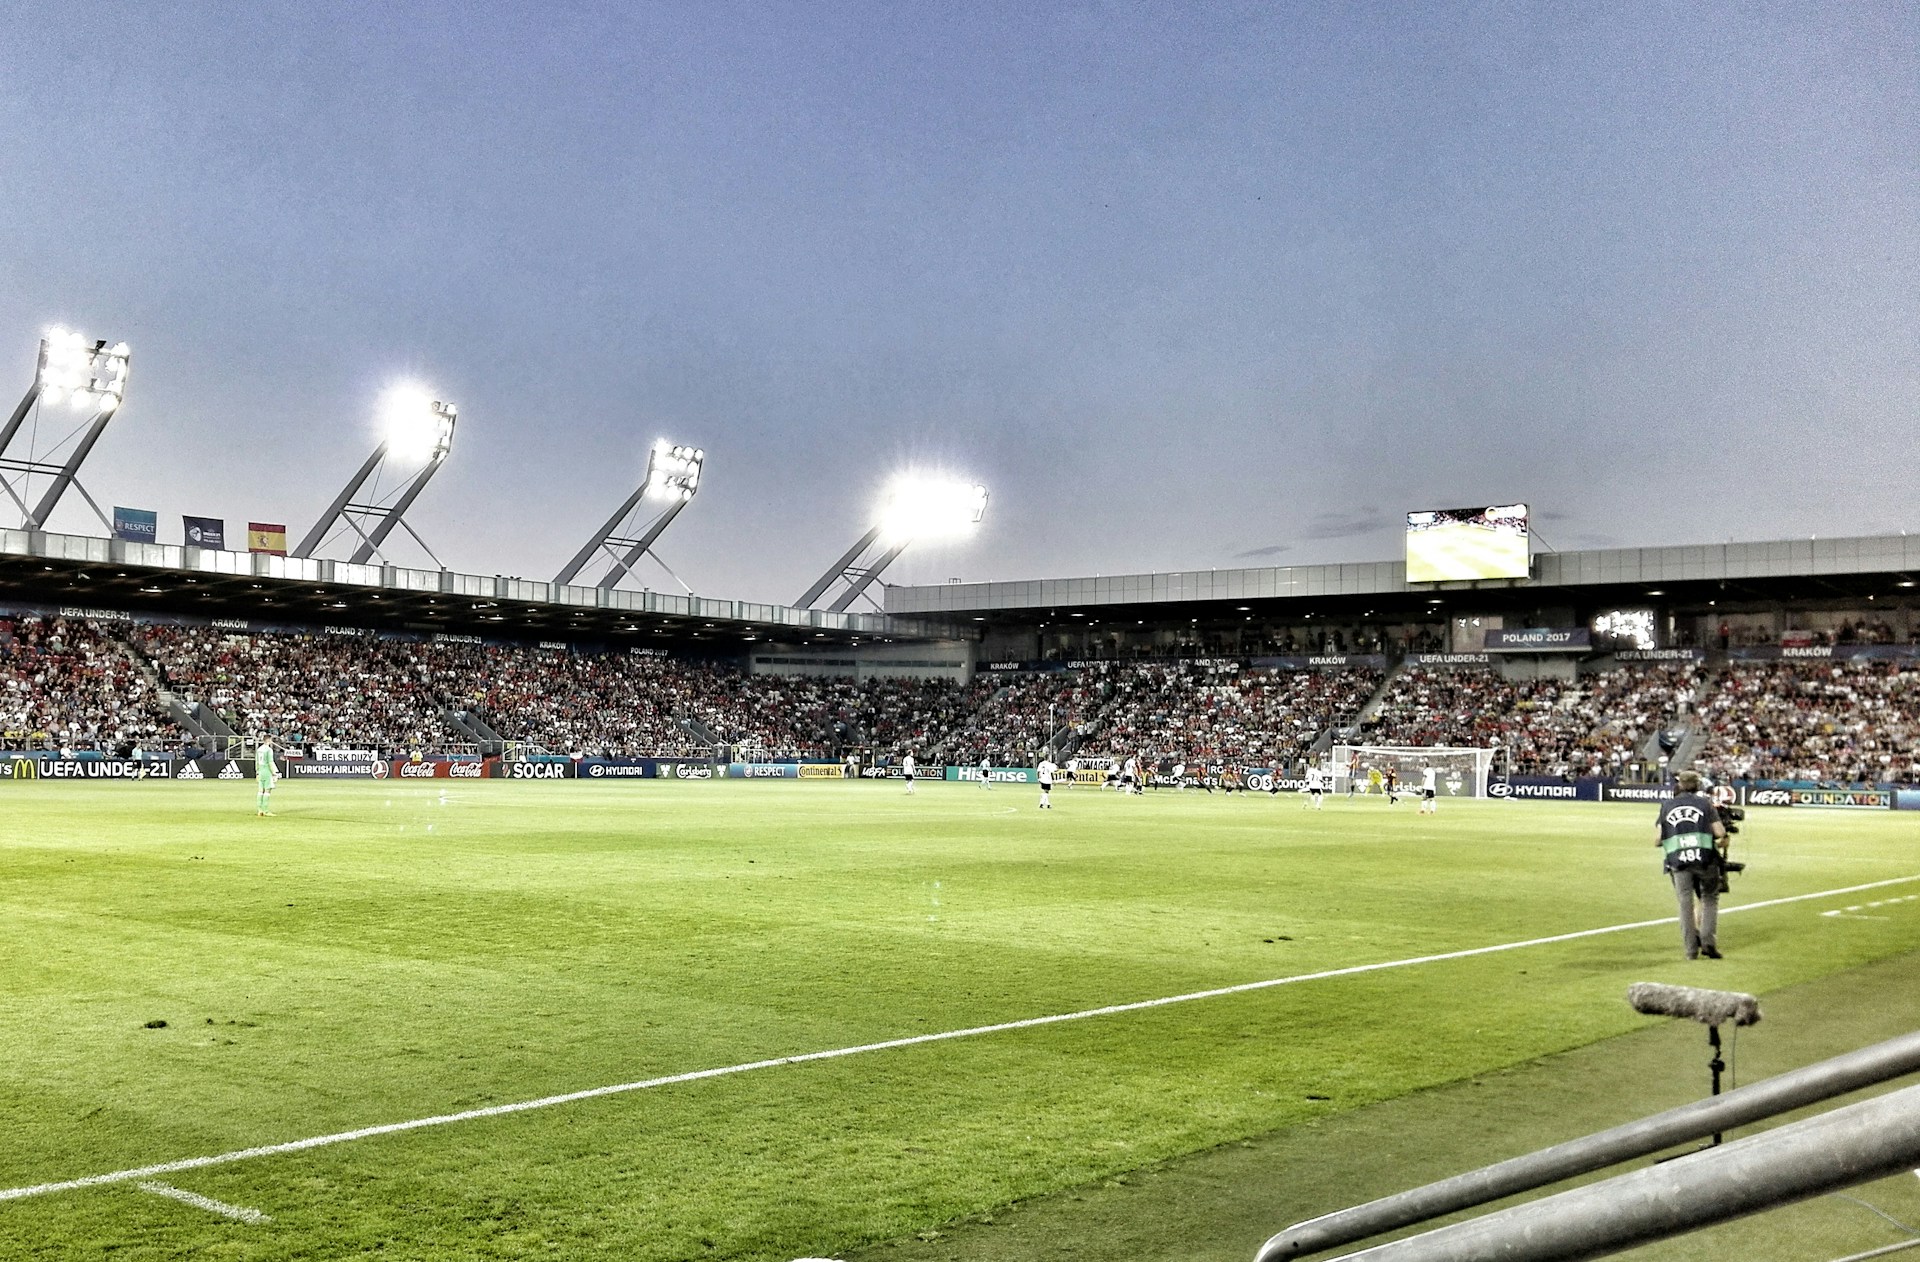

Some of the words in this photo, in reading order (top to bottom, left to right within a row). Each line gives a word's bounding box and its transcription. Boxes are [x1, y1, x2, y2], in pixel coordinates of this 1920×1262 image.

[124, 522, 155, 534] RESPECT
[59, 607, 85, 618] UEFA
[85, 609, 131, 621] UNDER-21
[211, 618, 249, 629] KRAKÓW
[324, 625, 356, 636] POLAND
[449, 634, 483, 644] UNDER-21
[1502, 632, 1544, 643] POLAND
[1545, 632, 1571, 642] 2017
[539, 641, 567, 650] KRAKÓW
[630, 647, 654, 655] POLAND
[1616, 650, 1642, 660] UEFA
[1643, 650, 1694, 660] UNDER-21
[1782, 647, 1832, 657] KRAKÓW
[1309, 656, 1346, 665] KRAKÓW
[1419, 654, 1443, 663] UEFA
[1444, 654, 1489, 663] UNDER-21
[990, 662, 1019, 670] KRAKÓW
[1067, 661, 1086, 669] UEFA
[40, 761, 85, 777] UEFA
[88, 761, 169, 777] UNDE-21
[294, 765, 333, 774] TURKISH
[333, 765, 371, 774] AIRLINES
[513, 763, 565, 778] SOCAR
[605, 766, 643, 776] HYUNDAI
[675, 763, 712, 779] Carlsberg
[754, 766, 786, 777] RESPECT
[798, 765, 838, 777] Continental
[887, 767, 943, 777] FOUATION
[957, 766, 1028, 782] Hisense
[176, 771, 204, 780] adidas
[217, 771, 244, 780] adidas
[1515, 785, 1577, 797] HYUNDAI
[1608, 788, 1659, 799] TURKISH
[1750, 790, 1792, 805] UEFA
[1791, 792, 1891, 806] FOUNDATION
[1667, 806, 1702, 826] UEFA
